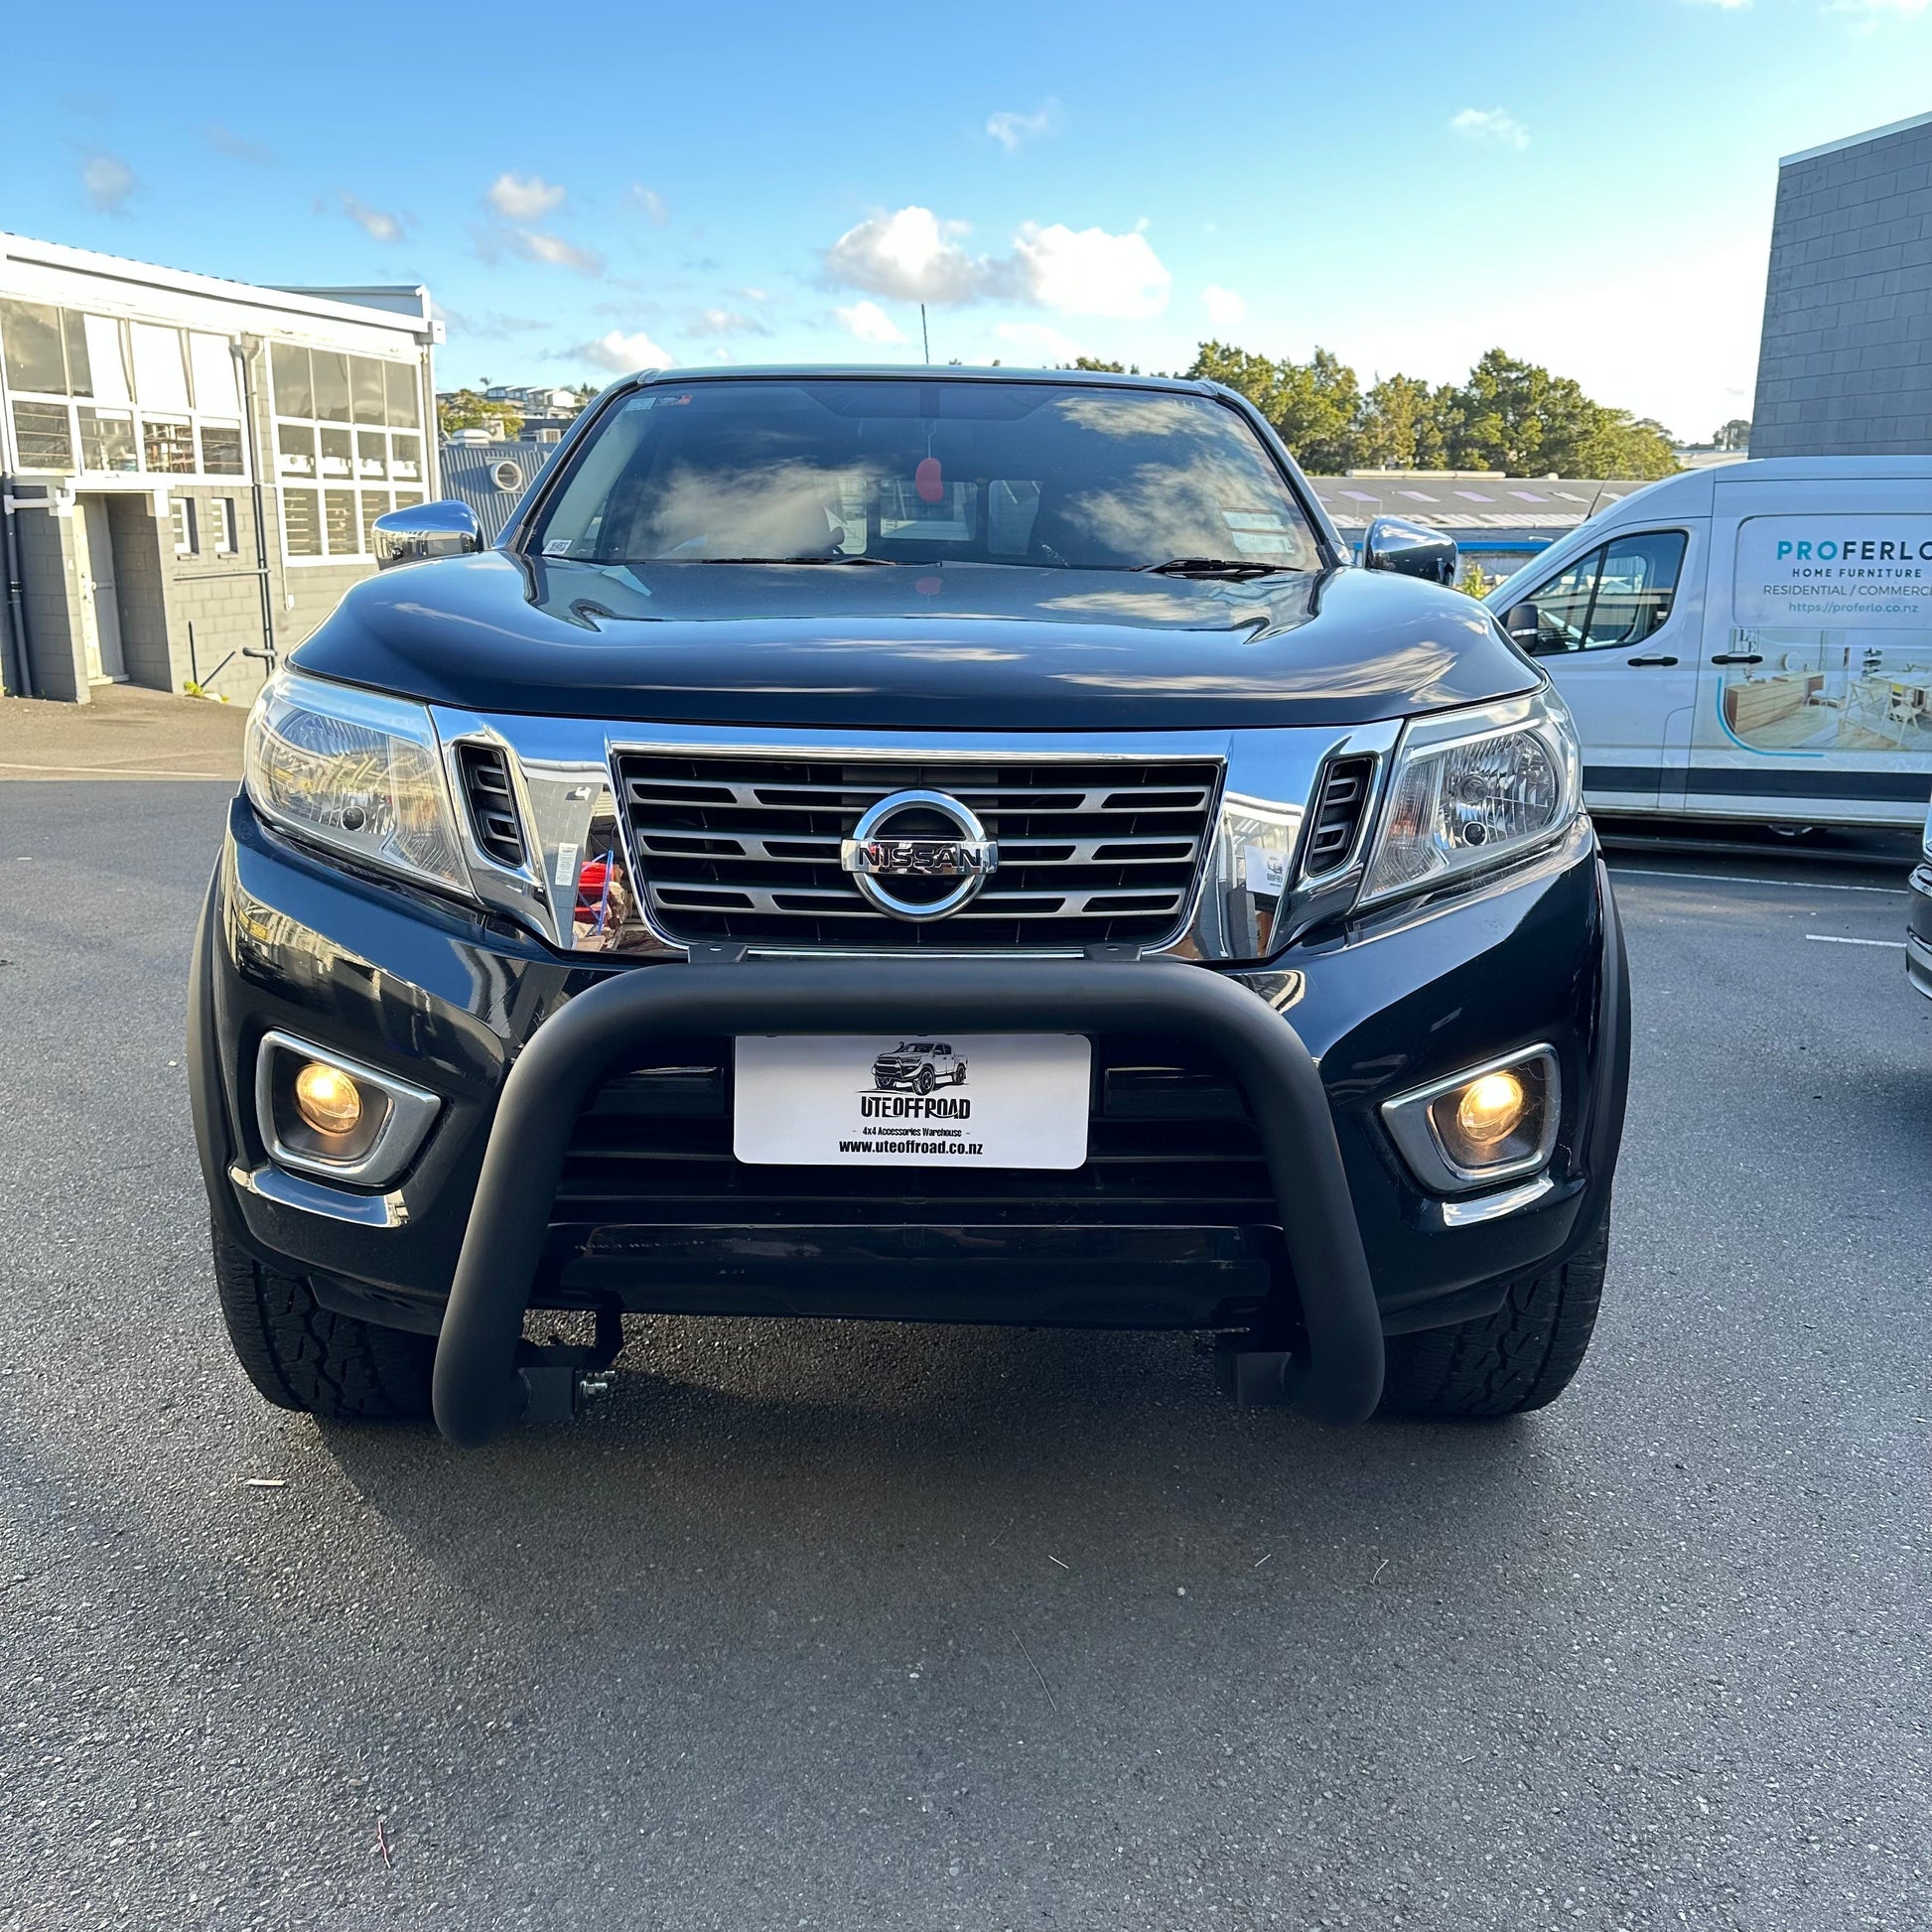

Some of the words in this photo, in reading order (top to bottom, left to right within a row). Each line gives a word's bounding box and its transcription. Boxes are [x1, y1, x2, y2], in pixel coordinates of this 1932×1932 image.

[1777, 540, 1932, 560] PROFERLO
[1792, 568, 1832, 578] HOME
[1839, 568, 1922, 578] FURNITURE
[1763, 585, 1847, 596] RESIDENTIAL
[1789, 602, 1919, 614] https://proferlo.co.nz
[858, 847, 981, 868] NISSAN
[861, 1096, 971, 1119] UTEOFFROAD
[862, 1127, 877, 1136] 4x4
[878, 1127, 921, 1137] Accessories
[922, 1128, 962, 1137] Warehouse
[839, 1141, 983, 1155] www.uteoffroad.co.nz
